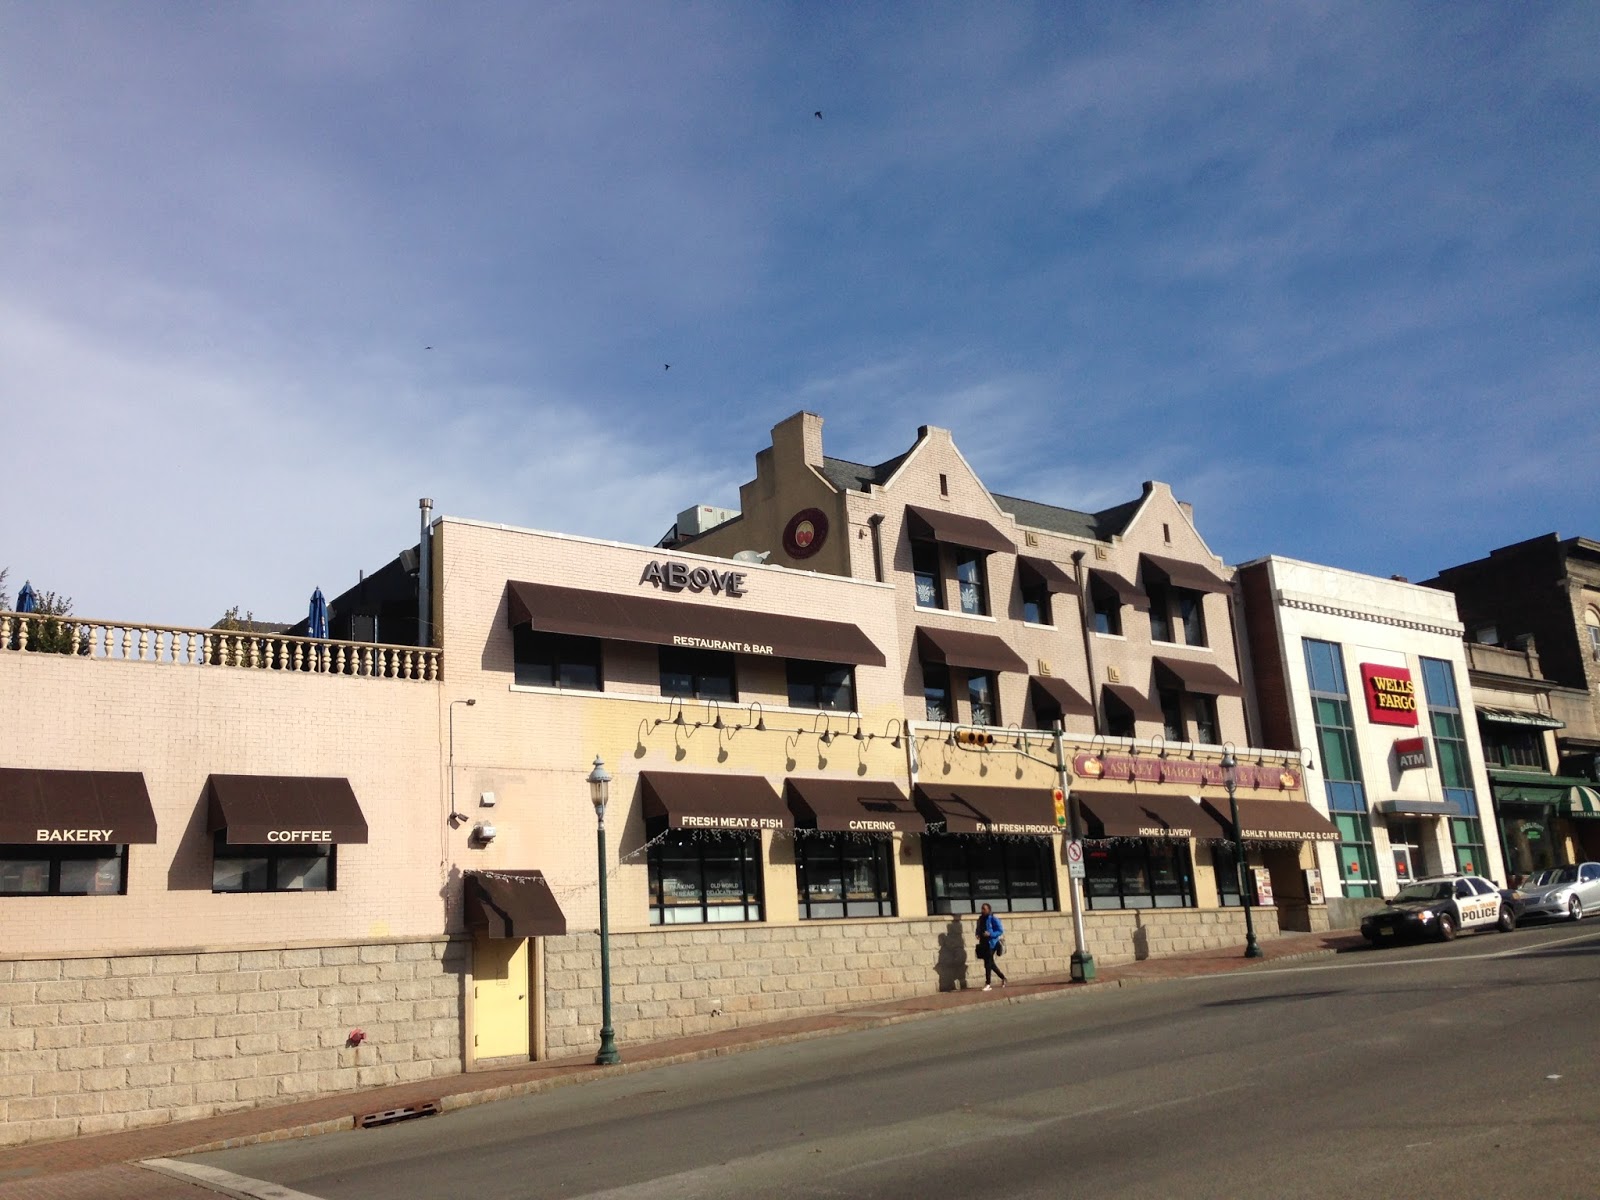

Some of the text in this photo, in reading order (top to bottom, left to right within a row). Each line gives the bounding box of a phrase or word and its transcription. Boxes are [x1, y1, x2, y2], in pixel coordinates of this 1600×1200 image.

[645, 560, 748, 594] ABOVE
[673, 635, 773, 654] RESTAURANT & BAR
[1373, 676, 1415, 694] WELLS
[1378, 692, 1417, 710] FARGO
[1400, 753, 1425, 766] ATM
[682, 816, 783, 828] FRESH MEAT & FISH
[849, 820, 896, 830] CATERING
[976, 823, 999, 832] FARM
[999, 823, 1025, 833] FRESH
[36, 829, 114, 842] BAKERY
[267, 830, 332, 842] COFFEE
[1139, 828, 1192, 837] HOME DELIVERY
[1241, 829, 1339, 840] ASHLEY MARKETPLACE & CAFE
[1461, 907, 1497, 921] POLICE
